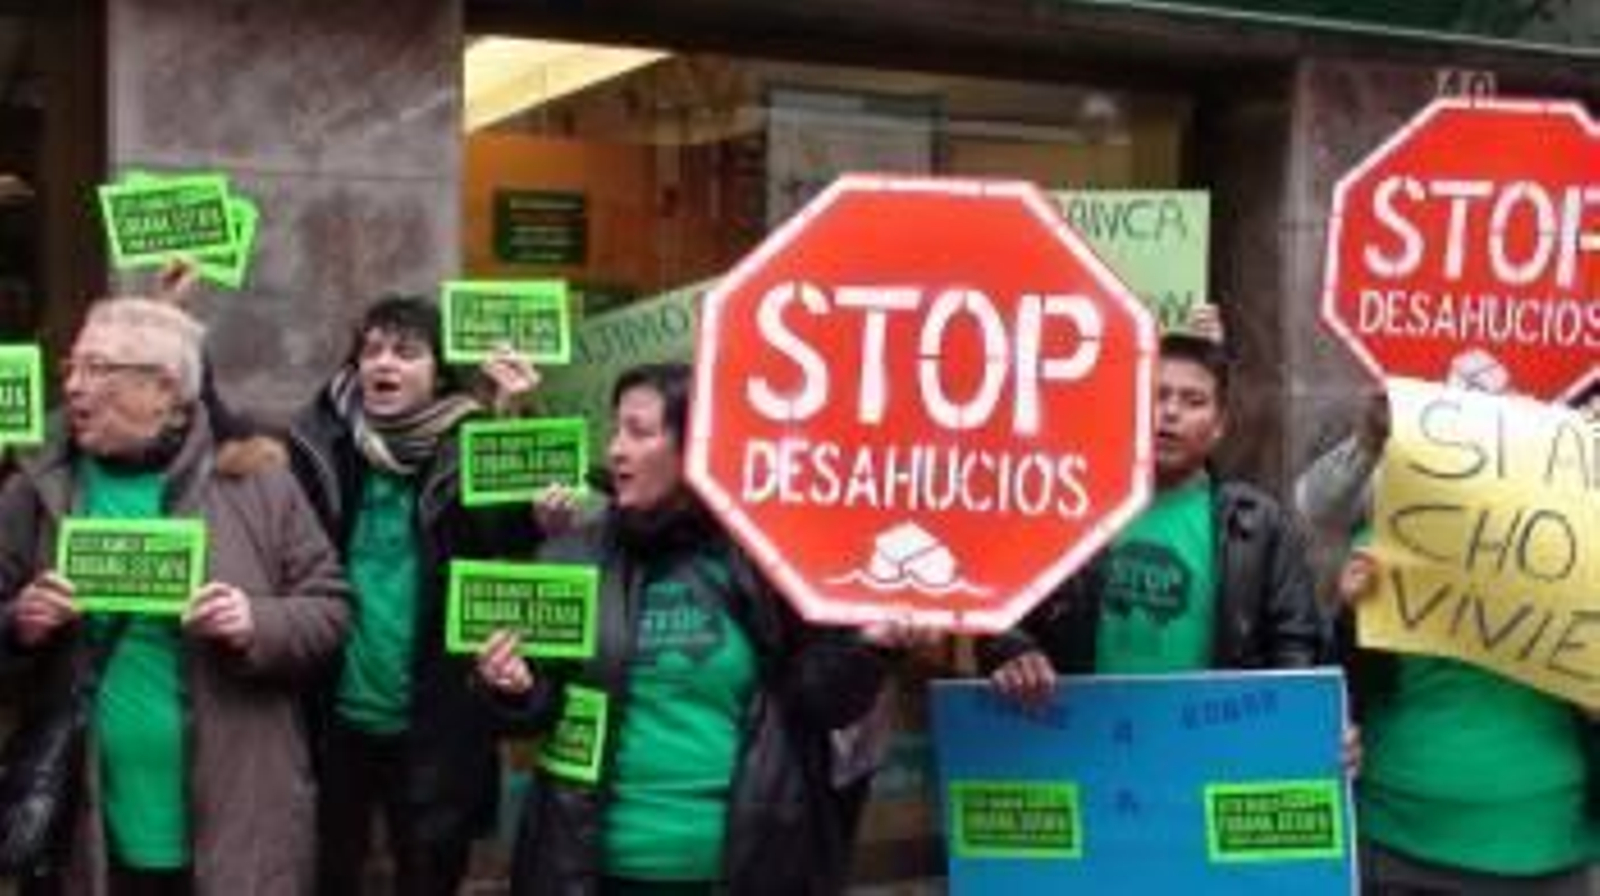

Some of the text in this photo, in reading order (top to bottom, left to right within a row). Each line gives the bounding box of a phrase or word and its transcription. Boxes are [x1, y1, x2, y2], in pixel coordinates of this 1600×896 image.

[746, 280, 1101, 436] STOP
[741, 436, 1091, 519] DESAHUCIOS
[1408, 399, 1506, 479] SI
[1389, 504, 1577, 583] CHO
